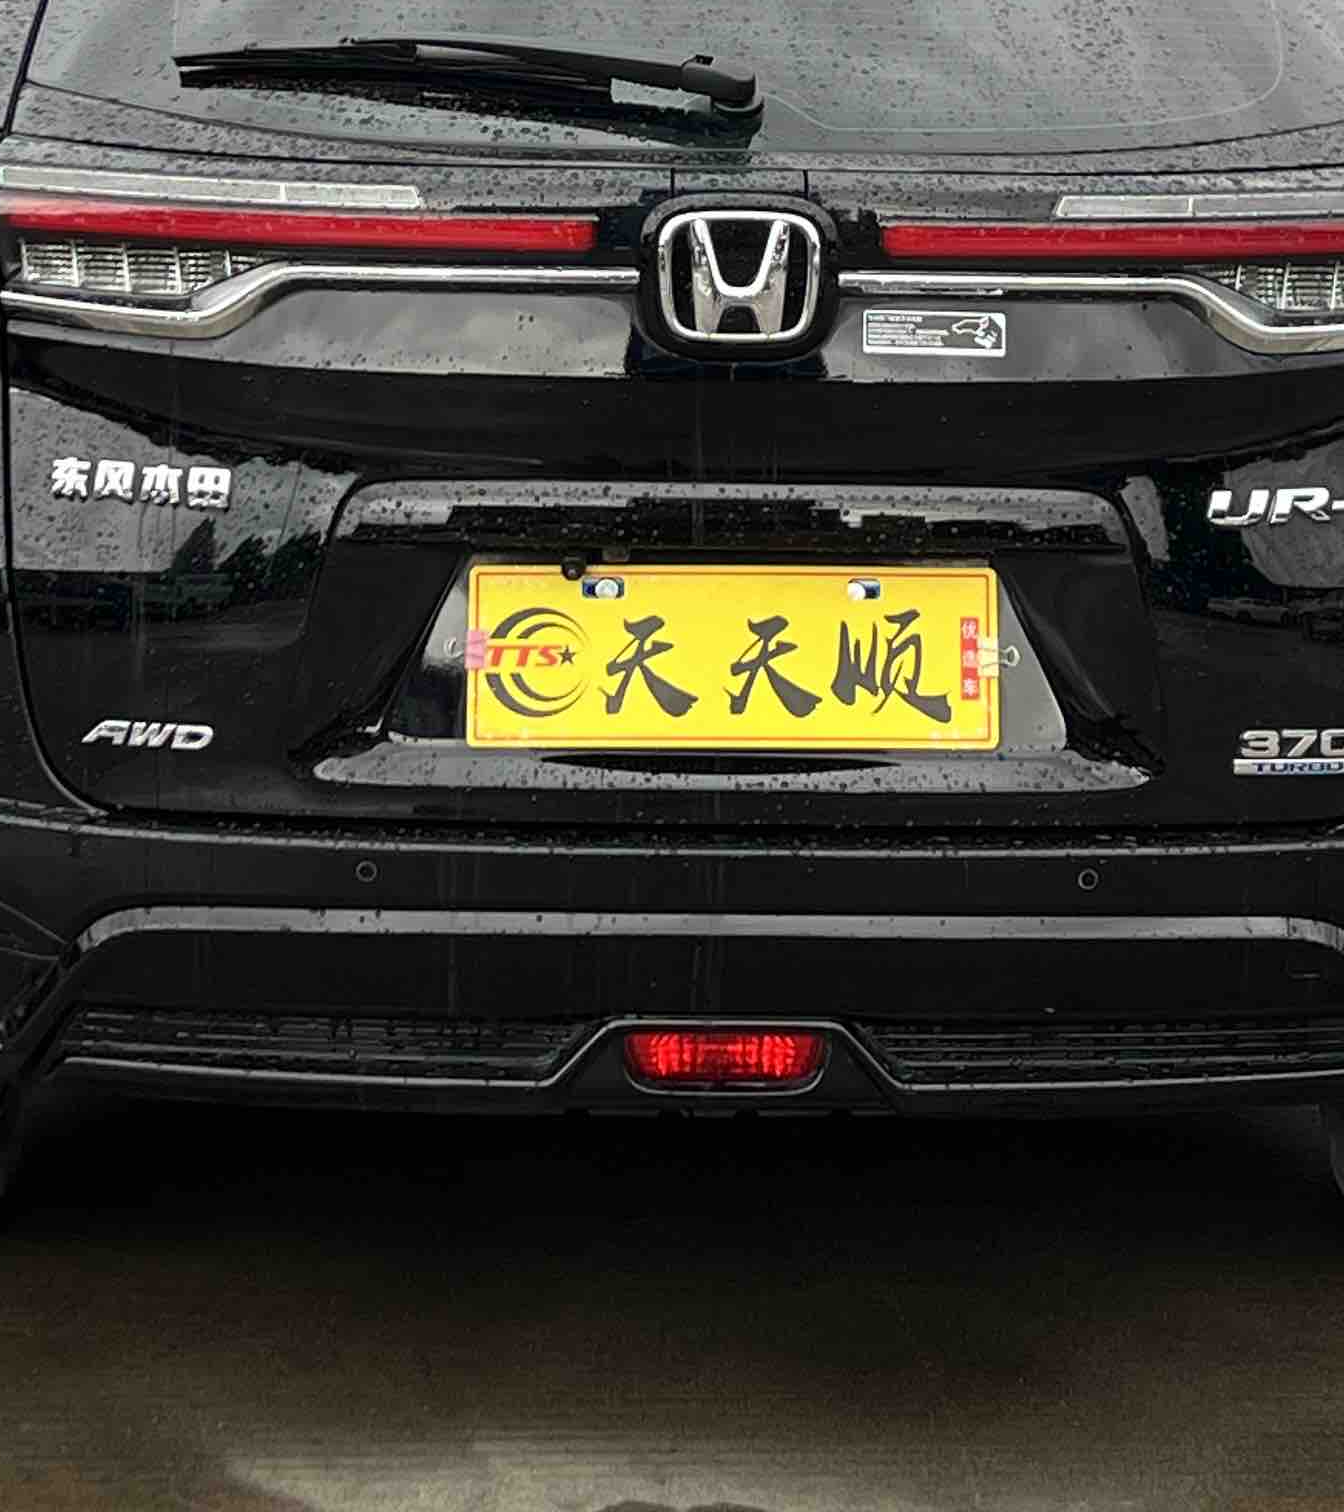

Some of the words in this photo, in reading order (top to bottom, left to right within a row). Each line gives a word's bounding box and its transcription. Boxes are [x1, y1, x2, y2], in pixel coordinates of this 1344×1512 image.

[50, 456, 232, 509] 东风本田
[486, 644, 559, 668] TTS
[598, 609, 952, 724] 天天顺
[81, 719, 214, 750] AWD
[1252, 762, 1344, 773] TURBO
